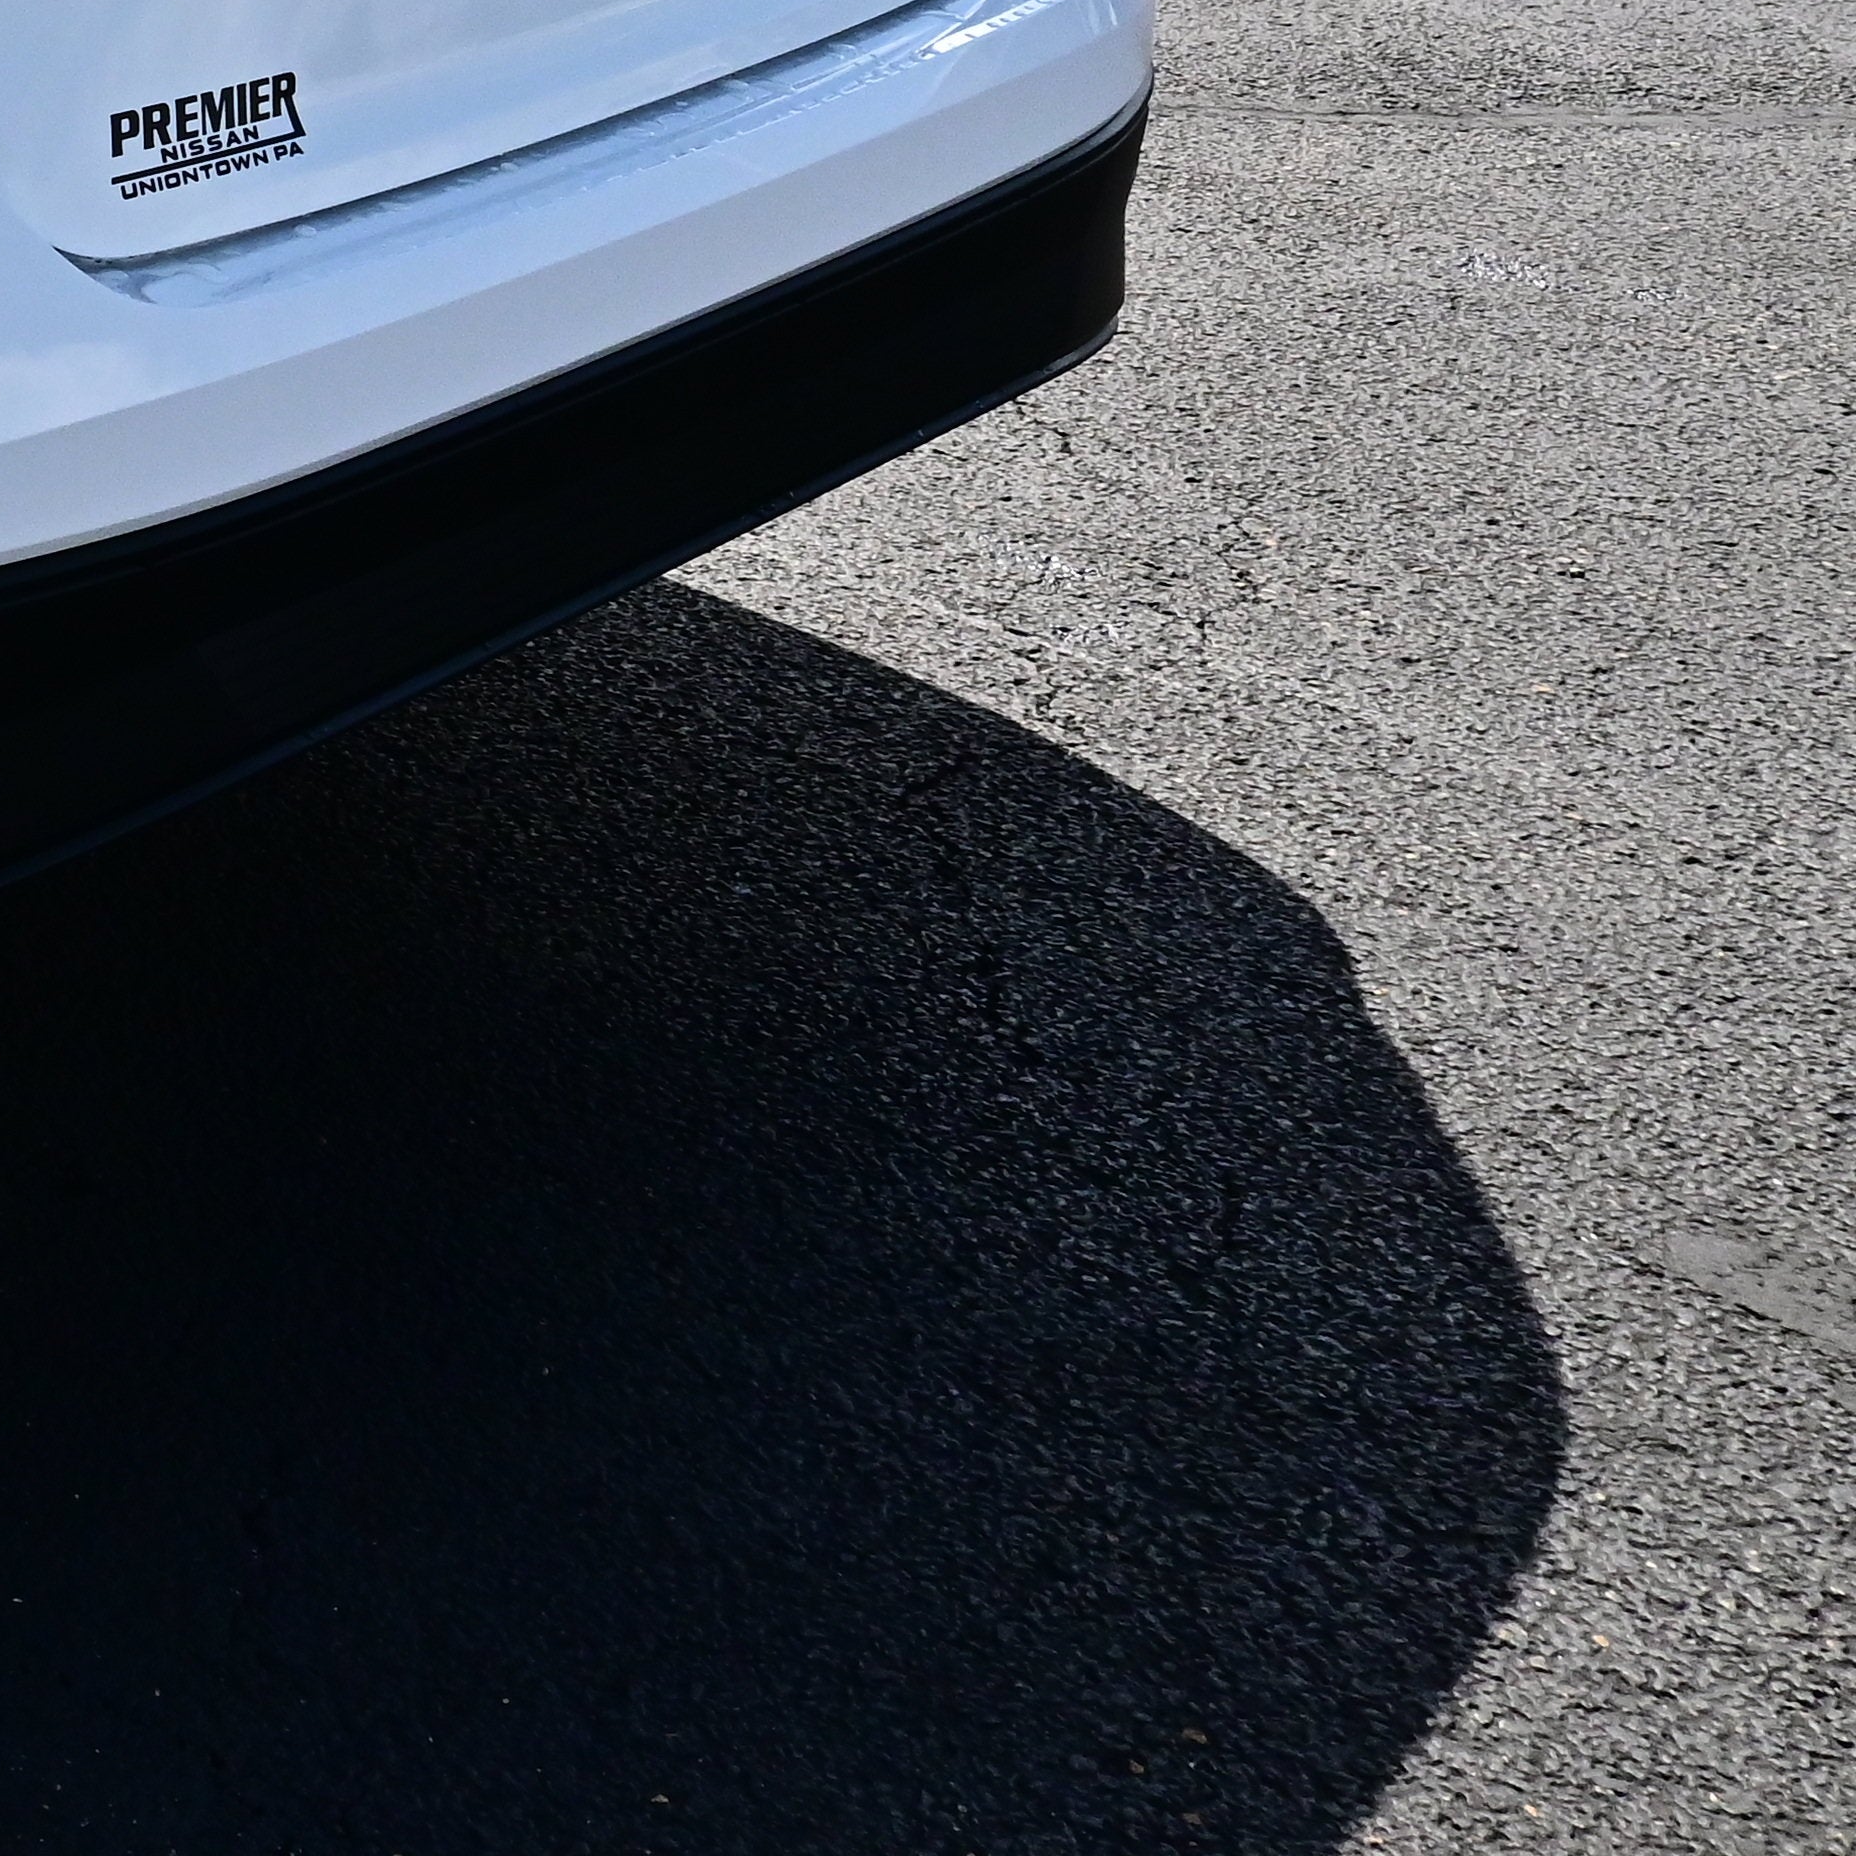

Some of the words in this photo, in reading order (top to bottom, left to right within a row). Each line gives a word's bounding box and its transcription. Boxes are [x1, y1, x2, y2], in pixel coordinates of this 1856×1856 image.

[109, 71, 307, 158] PREMIER
[160, 125, 260, 163] NISSAN
[120, 151, 270, 200] UNIONTOWN
[274, 141, 305, 161] PA
